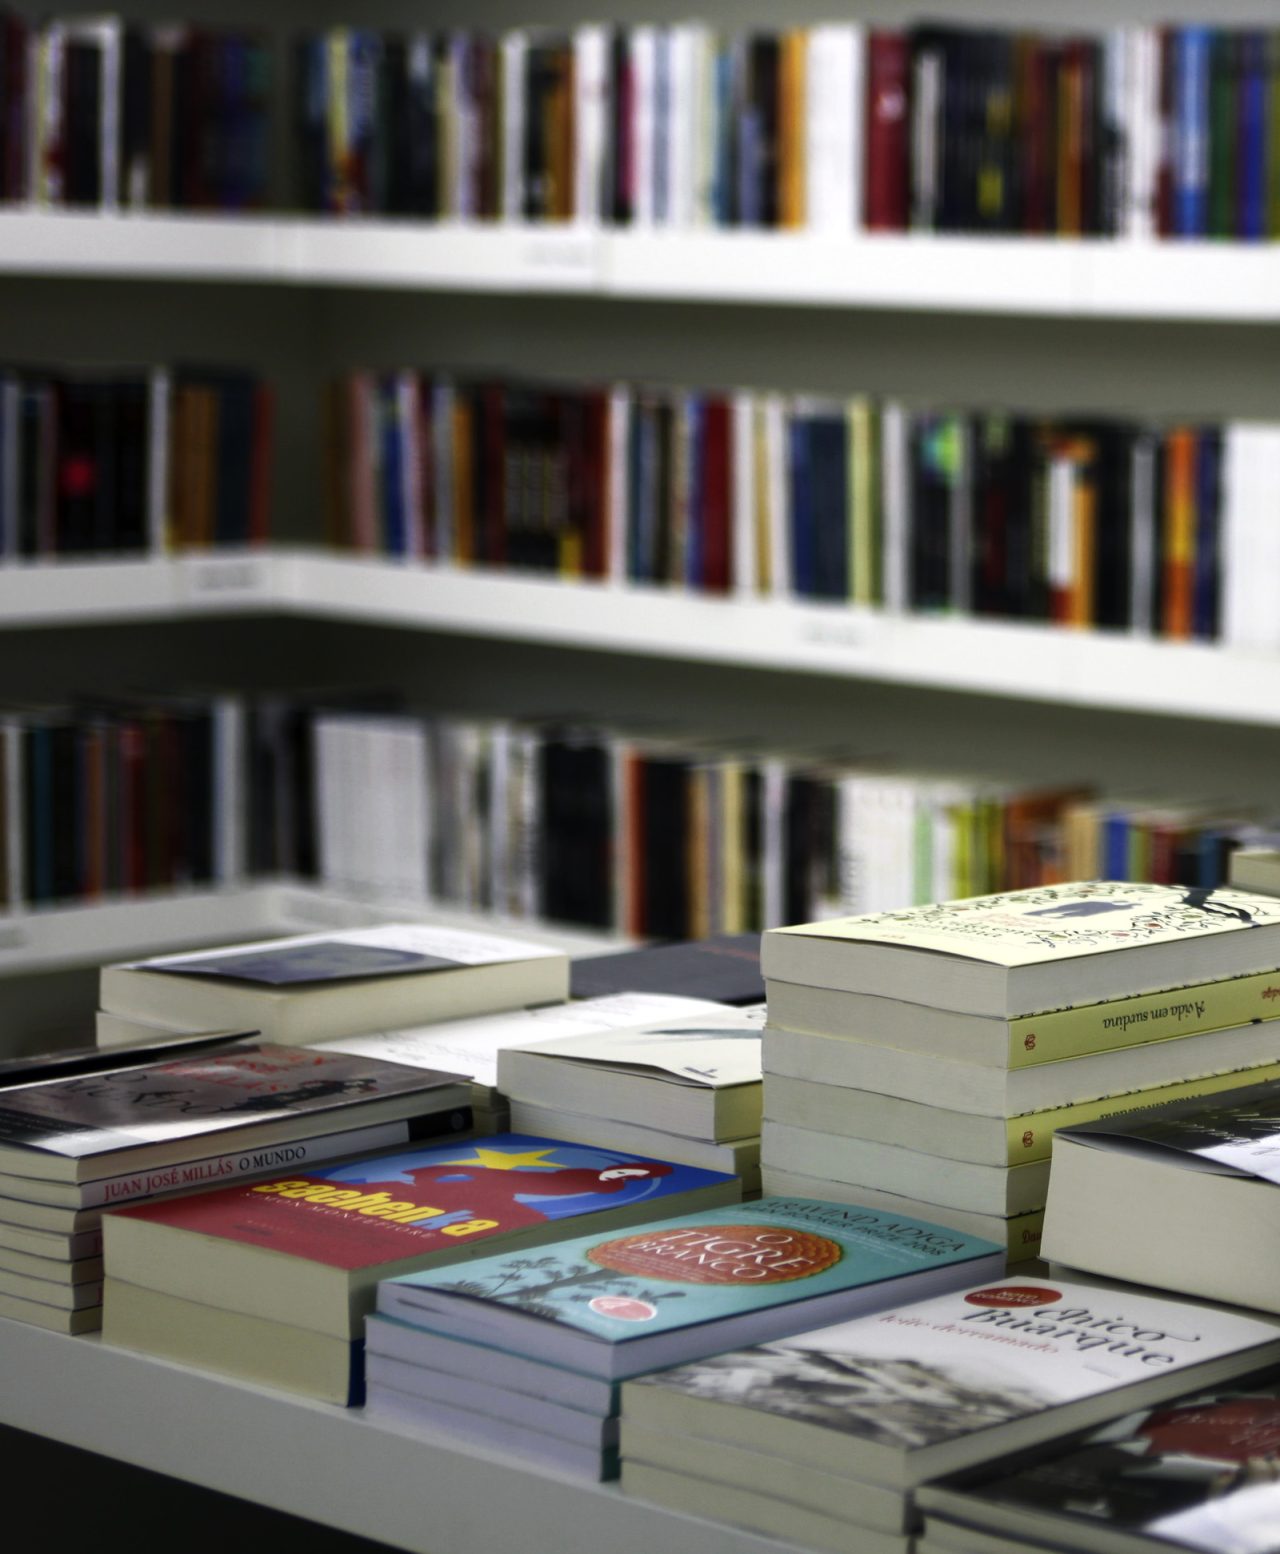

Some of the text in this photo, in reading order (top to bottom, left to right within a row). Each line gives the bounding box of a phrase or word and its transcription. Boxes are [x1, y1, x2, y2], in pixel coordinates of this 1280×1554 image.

[1102, 1011, 1149, 1031] surdina
[1151, 1009, 1169, 1019] em
[1168, 1003, 1197, 1021] vida
[104, 1146, 306, 1201] JUAN JOSÉ MILLÁS O MUNDO
[252, 1180, 499, 1237] sachenka
[765, 1200, 966, 1252] ARAVIND ADIGA
[666, 1230, 816, 1273] TIGRE
[756, 1234, 794, 1245] O
[782, 1211, 853, 1229] BOOKER
[855, 1226, 900, 1242] PRIZE
[902, 1239, 947, 1256] 2008
[627, 1242, 768, 1279] BRANCO
[930, 1321, 1059, 1354] derramado
[961, 1309, 1175, 1367] Buarque
[1033, 1308, 1201, 1342] Chico
